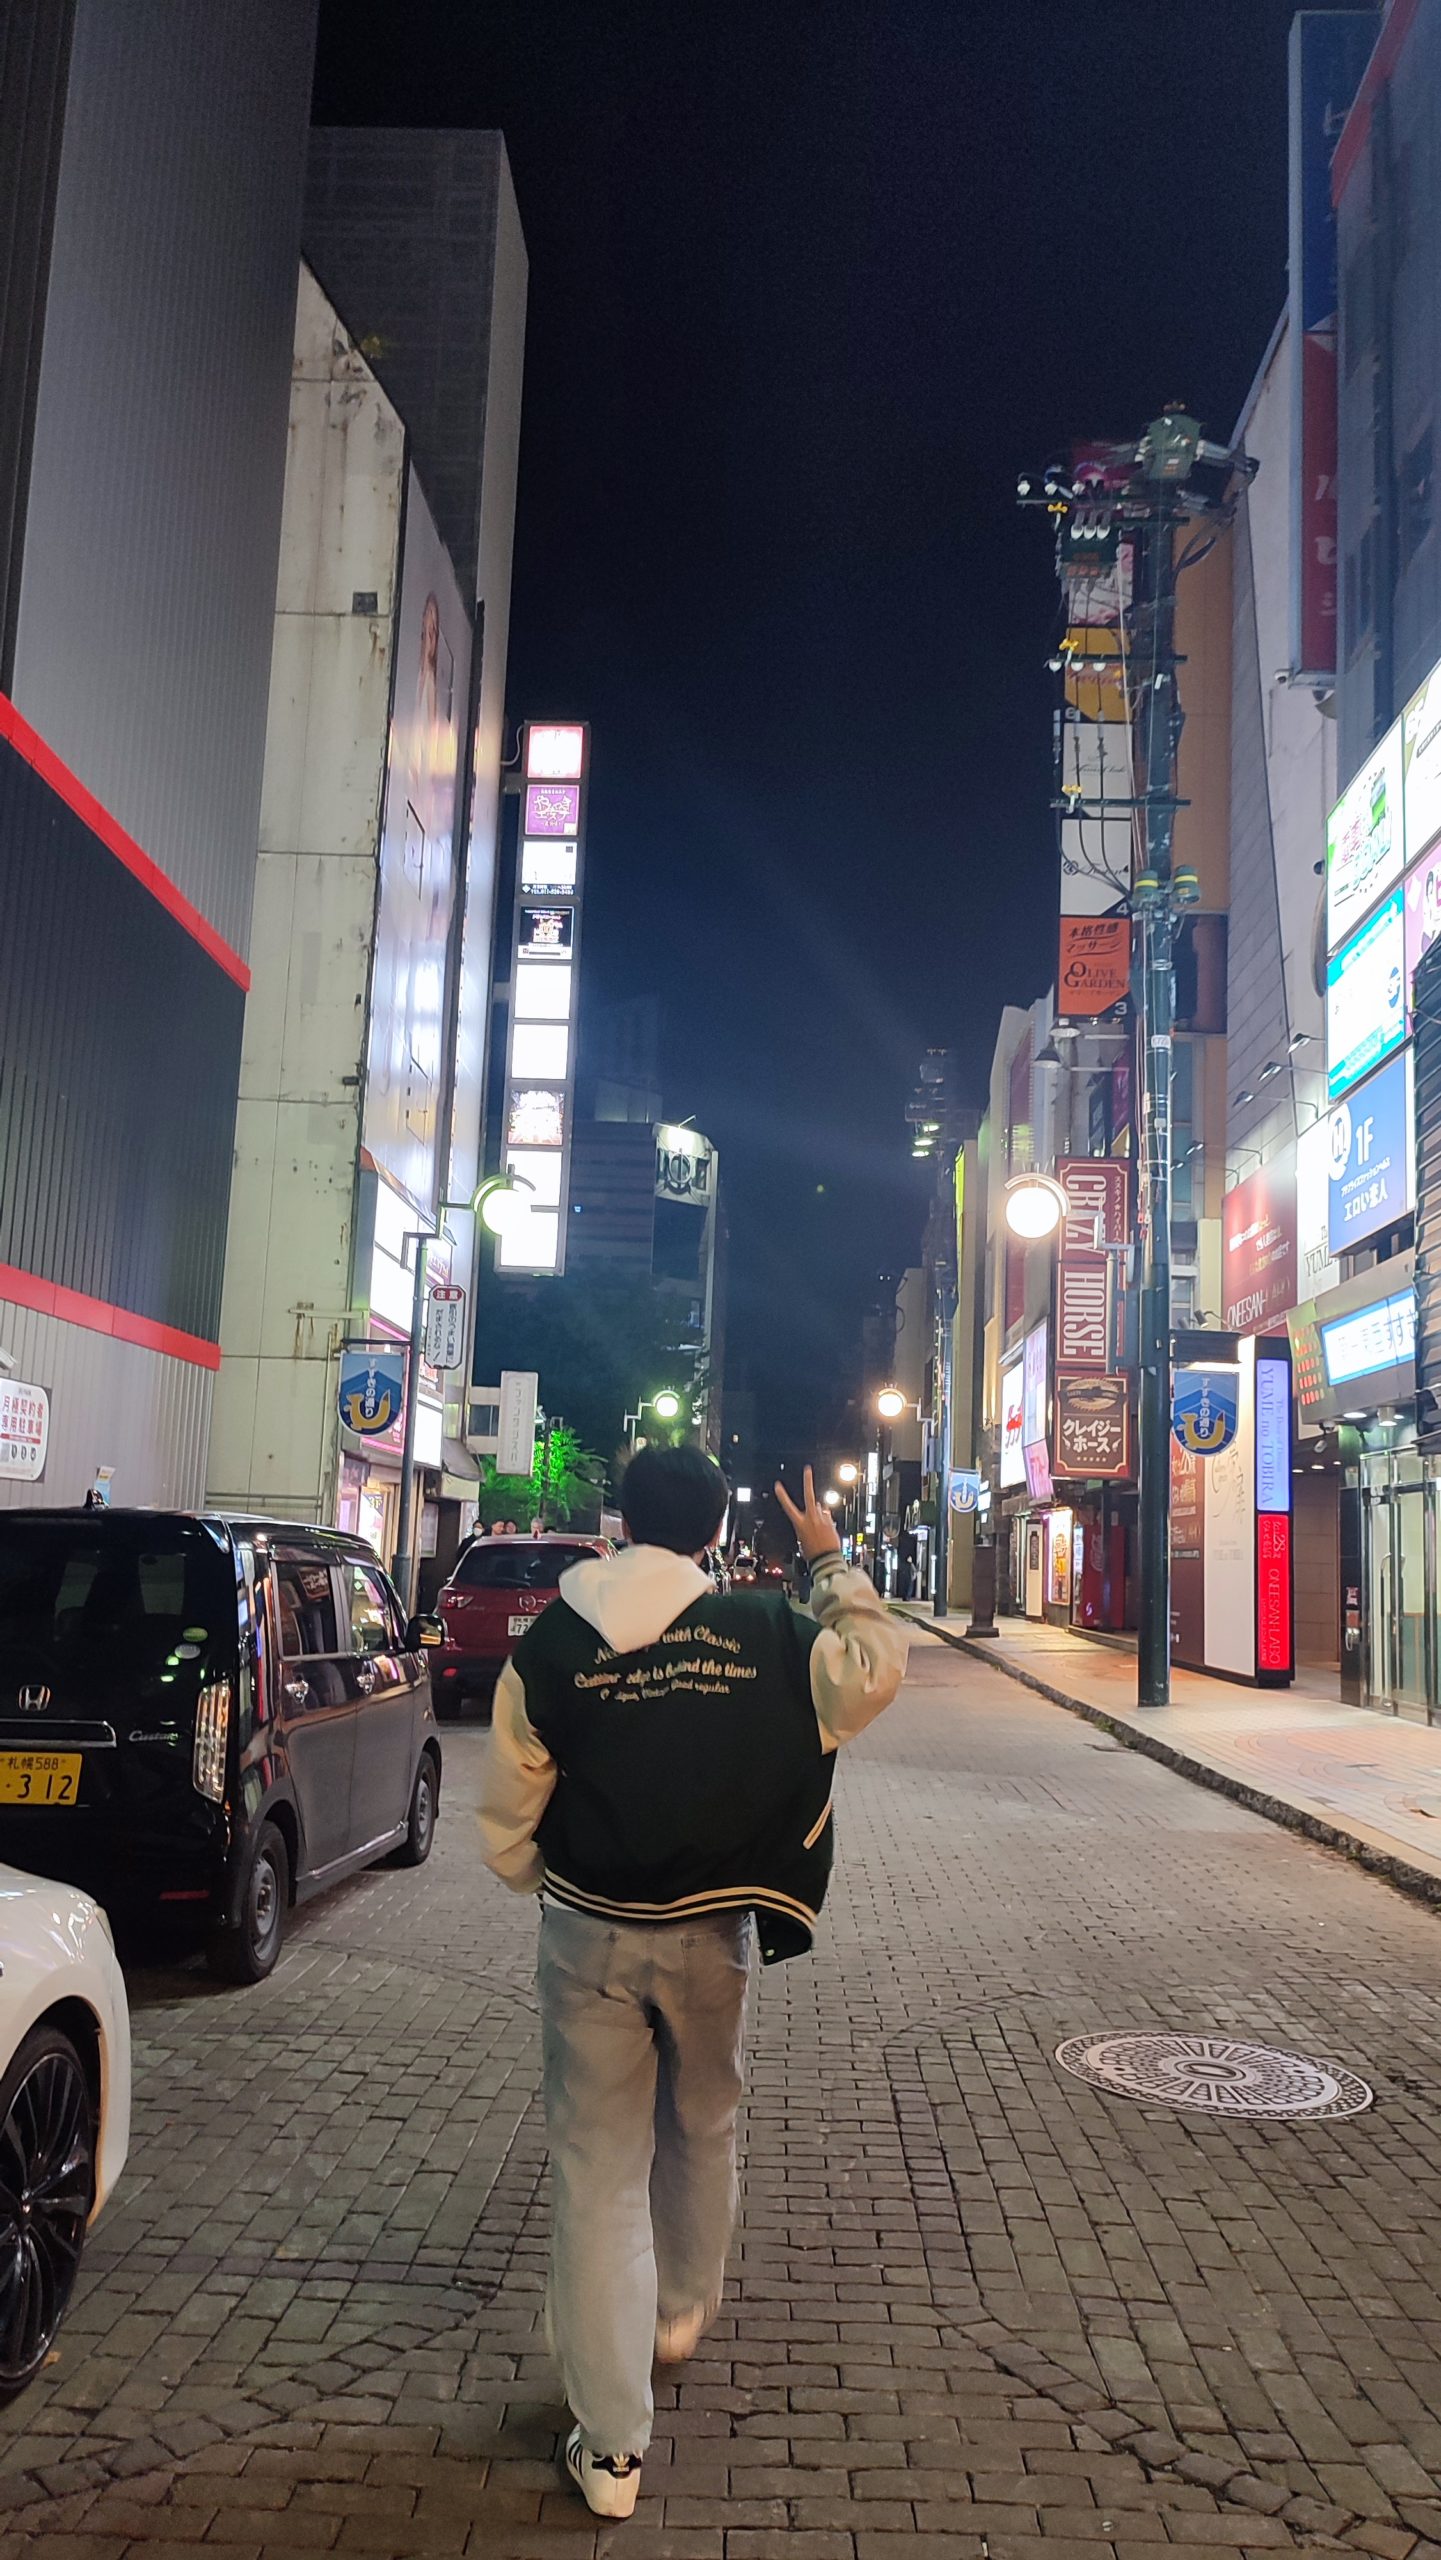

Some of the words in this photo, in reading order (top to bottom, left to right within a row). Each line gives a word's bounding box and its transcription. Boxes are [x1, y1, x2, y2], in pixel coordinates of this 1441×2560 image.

[1116, 902, 1129, 915] 4
[1070, 961, 1118, 978] OLIVE
[1064, 971, 1126, 988] GARDEN
[1114, 1001, 1127, 1015] 3
[1355, 1116, 1374, 1165] 1F
[436, 1289, 459, 1299] 注意
[1064, 1271, 1105, 1356] HORSE
[365, 1358, 377, 1417] すすきの通り
[1261, 1368, 1274, 1415] YUME
[3, 1395, 45, 1419] 月極契約者
[1199, 1377, 1211, 1438] すすきの通り
[2, 1415, 43, 1436] 専用駐車場
[1062, 1419, 1121, 1437] クレイジー
[1261, 1420, 1270, 1437] no
[1073, 1436, 1111, 1453] ホース
[1261, 1441, 1274, 1503] TOBIRA
[662, 1626, 692, 1643] with
[694, 1625, 741, 1654] Classic
[653, 1666, 664, 1681] is
[702, 1658, 722, 1677] the
[724, 1660, 757, 1679] times
[695, 1680, 730, 1695] regular
[8, 1757, 59, 1771] 札幌588
